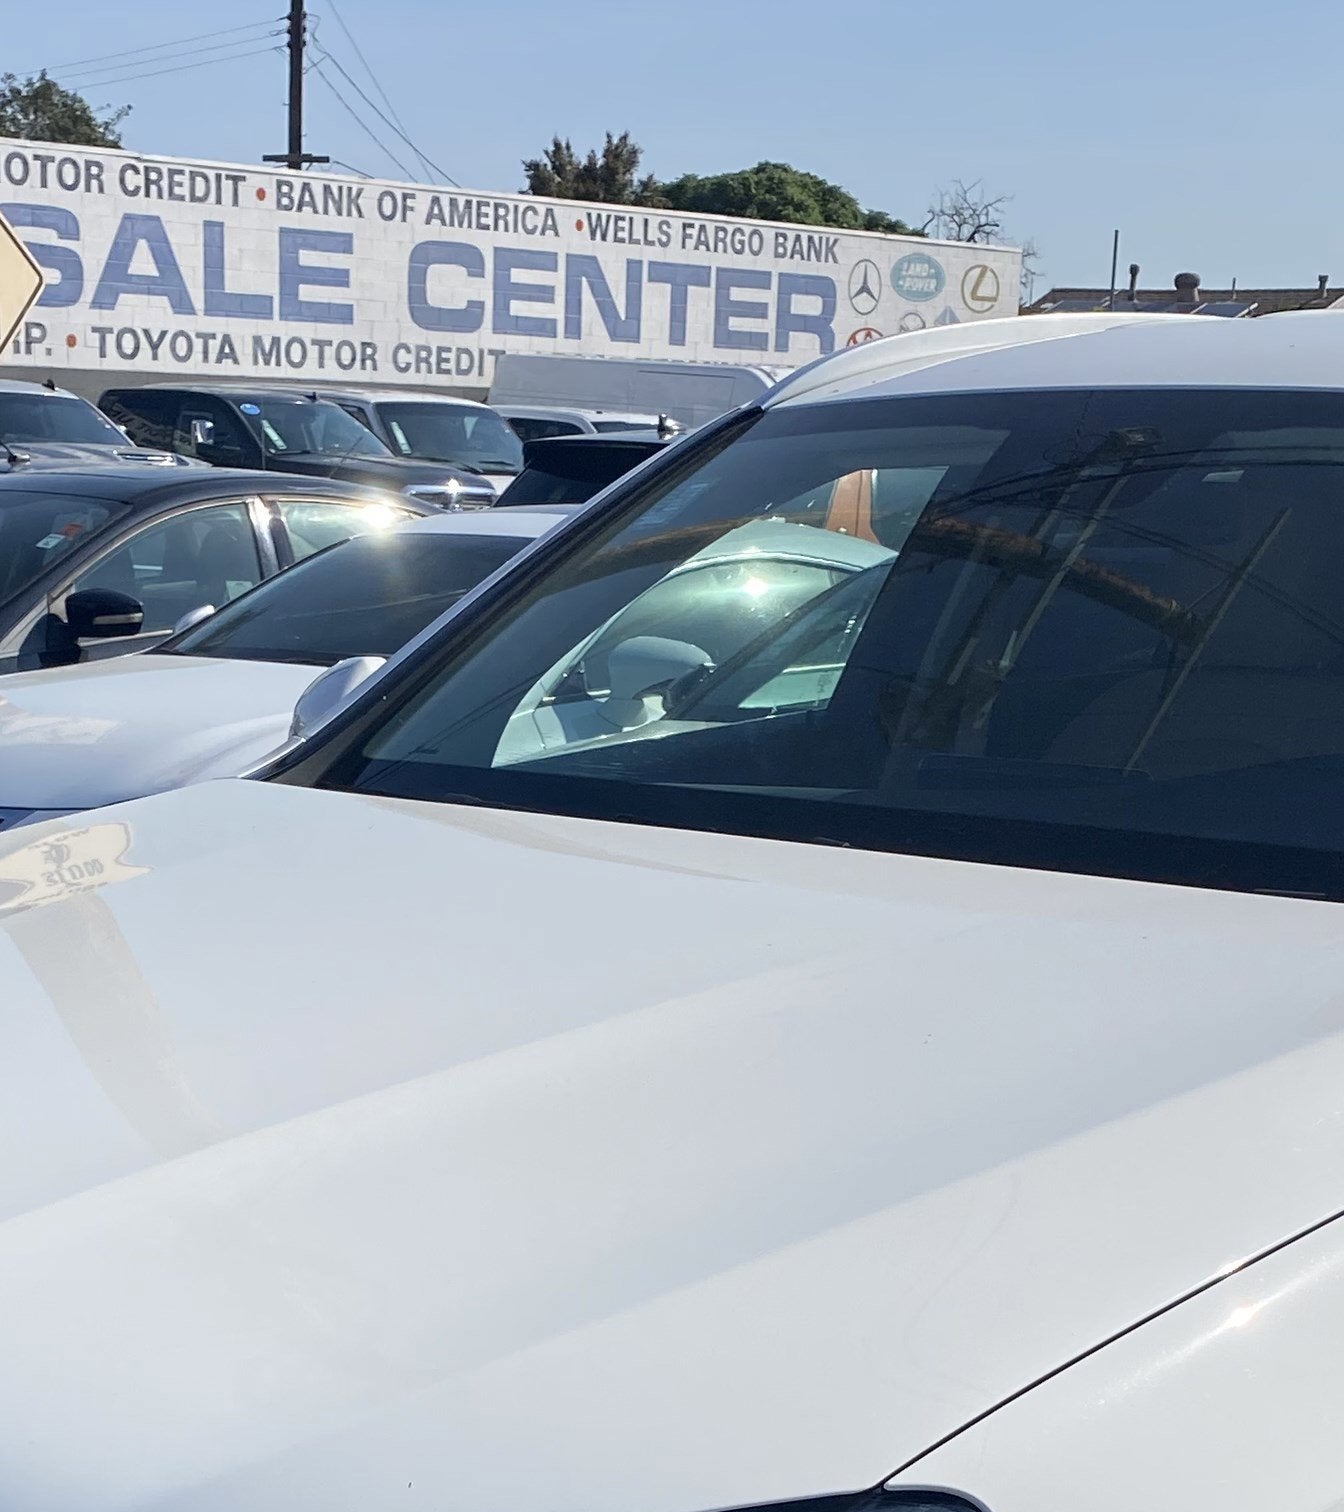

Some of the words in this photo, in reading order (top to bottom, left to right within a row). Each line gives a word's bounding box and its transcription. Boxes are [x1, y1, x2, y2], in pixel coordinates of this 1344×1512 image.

[119, 163, 245, 208] CREDIT
[276, 179, 365, 218] BANK
[377, 190, 416, 224] OF
[425, 193, 560, 238] AMERICA
[586, 212, 672, 249] WELLS
[682, 222, 764, 257] FARGO
[774, 232, 840, 265] BANK
[408, 240, 836, 354] CENTER
[92, 326, 238, 367] TOYOTA
[252, 336, 377, 373] MOTOR
